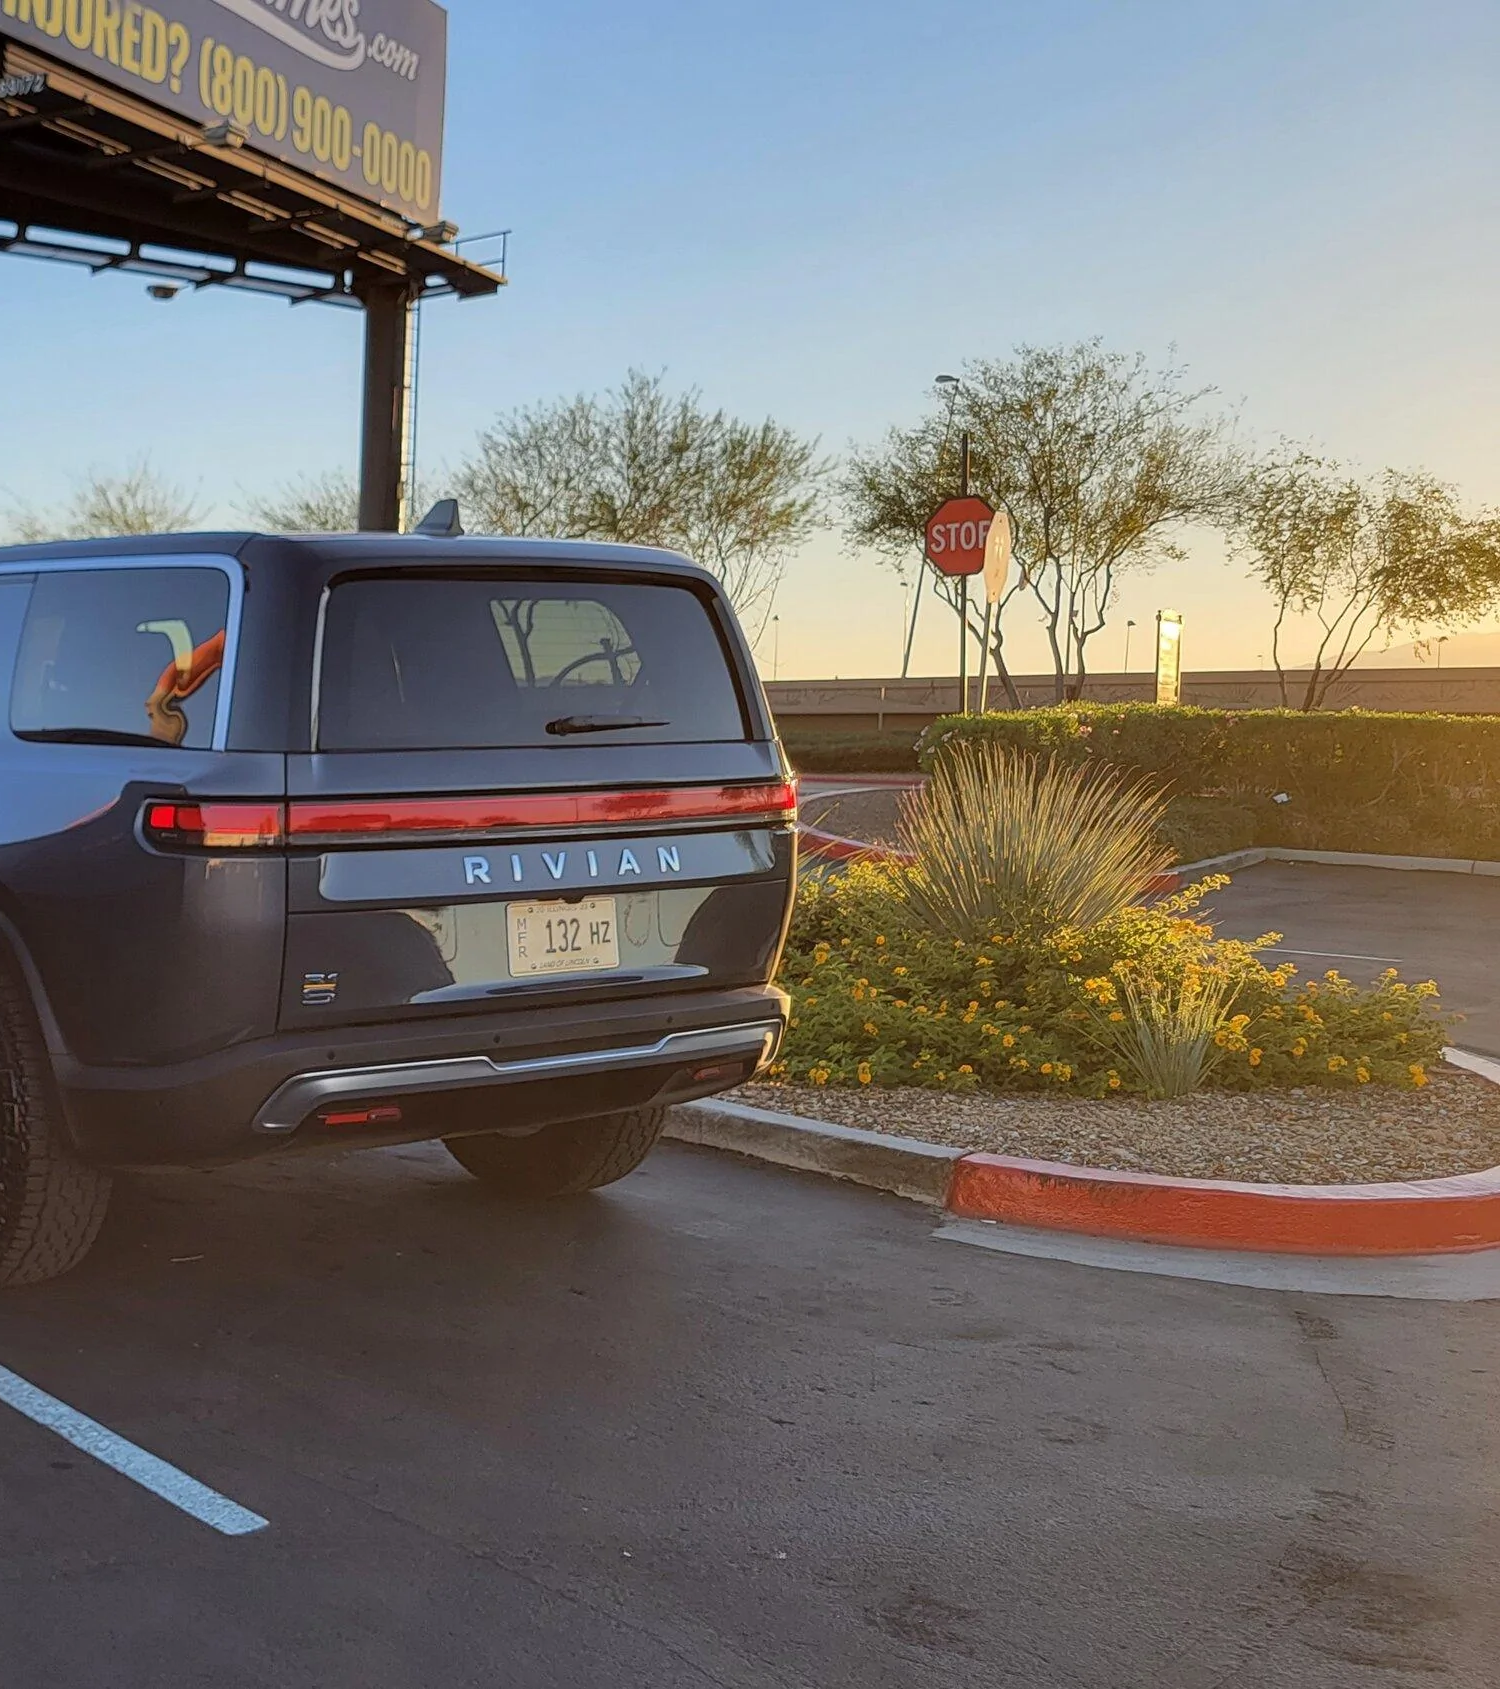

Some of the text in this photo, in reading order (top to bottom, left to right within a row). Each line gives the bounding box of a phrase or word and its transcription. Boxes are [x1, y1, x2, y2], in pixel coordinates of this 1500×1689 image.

[1, 0, 431, 210] JURED? (800) 900-0000
[463, 846, 681, 884] RIVIAN
[545, 918, 611, 953] 132 HZ
